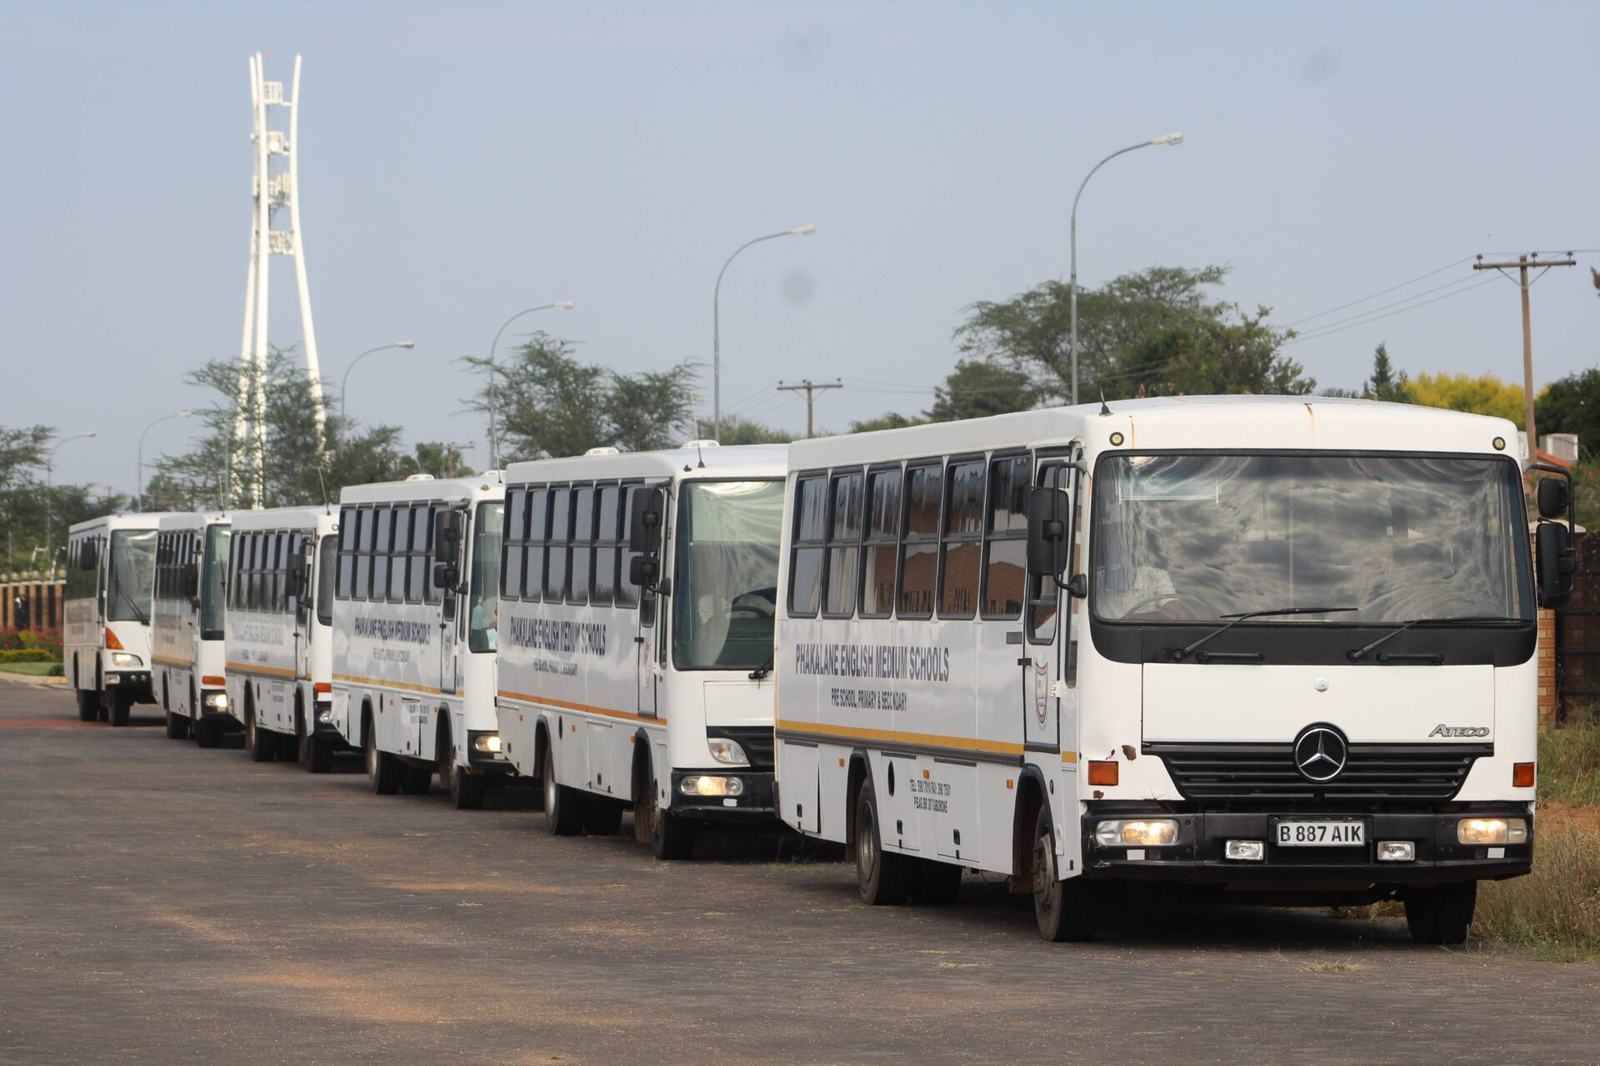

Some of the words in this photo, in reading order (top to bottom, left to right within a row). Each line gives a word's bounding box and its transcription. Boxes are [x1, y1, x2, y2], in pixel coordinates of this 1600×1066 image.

[796, 643, 839, 676] PHAKALANE
[841, 645, 874, 677] ENGLISH
[876, 646, 908, 679] MEDIUM
[909, 647, 949, 682] SCHOOLS
[831, 688, 840, 706] PRE
[858, 690, 877, 709] PRIMARY
[877, 691, 882, 710] &
[1280, 826, 1291, 841] B
[1296, 826, 1327, 841] 887
[1331, 826, 1361, 841] AIK
